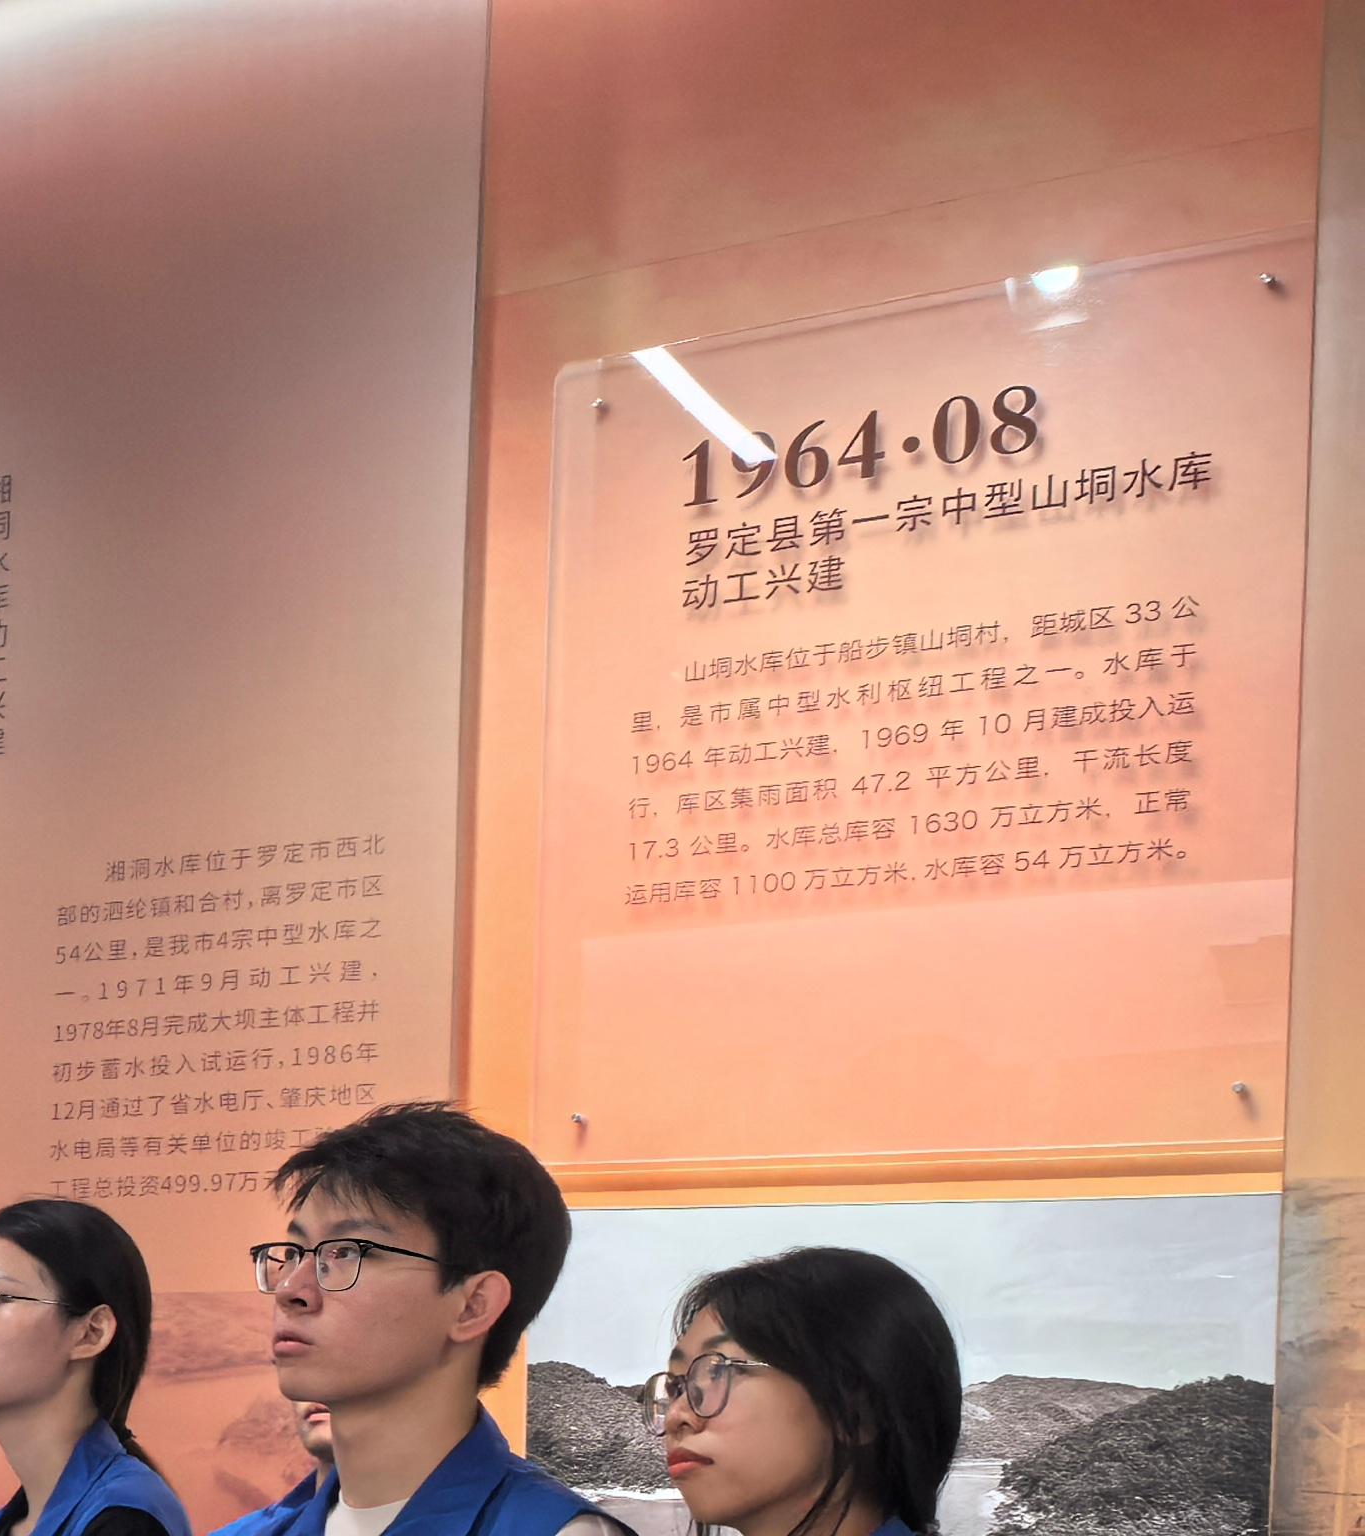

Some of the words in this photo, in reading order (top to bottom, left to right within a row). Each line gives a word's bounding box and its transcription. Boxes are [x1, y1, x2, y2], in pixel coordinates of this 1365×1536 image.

[686, 450, 1212, 566] 罗定县第一宗中型山垌水库
[682, 555, 845, 610] 动工兴建
[1125, 600, 1161, 623] 33
[632, 751, 693, 774] 1964
[862, 722, 928, 749] 1969
[941, 720, 963, 740] 年
[980, 713, 1011, 734] 10
[852, 771, 910, 792] 47.2
[105, 833, 386, 882] 湘洞水库位于罗定市西北
[630, 839, 679, 861] 17.3
[911, 810, 978, 834] 1630
[734, 872, 796, 895] 1100
[1015, 850, 1049, 871] 54
[49, 1128, 323, 1161] 水电局等有关单位的竣工
